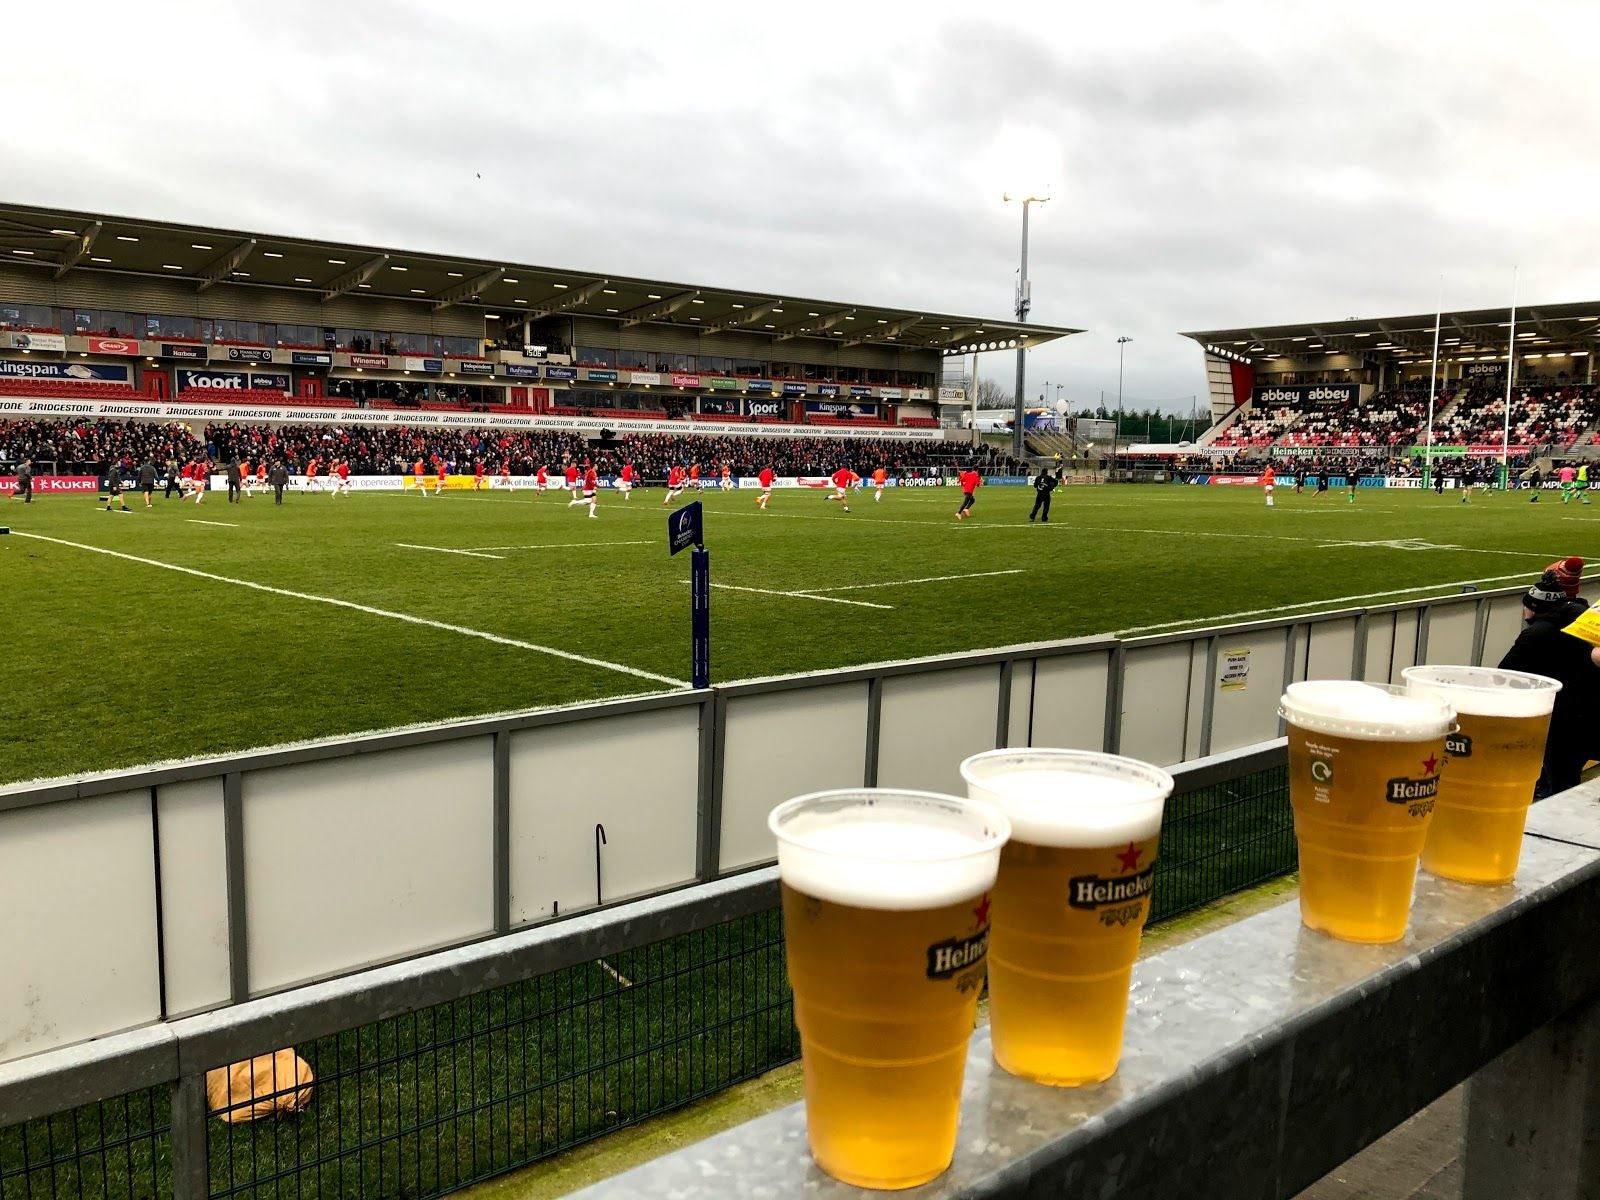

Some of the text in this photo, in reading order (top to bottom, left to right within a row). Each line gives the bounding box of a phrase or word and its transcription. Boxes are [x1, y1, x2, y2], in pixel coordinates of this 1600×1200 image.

[352, 357, 386, 366] Winemark
[1468, 363, 1502, 374] abbey
[253, 377, 273, 386] abbey
[674, 376, 699, 385] Tughans
[1261, 389, 1300, 403] abbey
[1308, 387, 1350, 401] abbey
[818, 403, 847, 413] Kingspan
[29, 402, 95, 413] BRIDGESTONE
[99, 404, 162, 415] BRIDGESTONE
[166, 407, 224, 417] BRIDGESTONE
[228, 409, 282, 418] BRIDGESTONE
[286, 410, 337, 420] BRIDGESTONE
[341, 412, 390, 421] BRIDGESTONE
[393, 414, 439, 423] BRIDGESTONE
[442, 415, 487, 424] BRIDGESTONE
[490, 417, 531, 425] BRIDGESTONE
[534, 418, 575, 426] BRIDGESTONE
[577, 420, 615, 428] BRIDGESTONE
[618, 421, 653, 430] BRIDGESTONE
[656, 422, 690, 430] BRIDGESTONE
[692, 424, 726, 432] BRIDGESTONE
[728, 425, 759, 433] BRIDGESTONE
[761, 426, 791, 434] BRIDGESTONE
[793, 427, 822, 436] BRIDGESTONE
[824, 428, 851, 436] BRIDGESTONE
[853, 429, 880, 437] BRIDGESTONE
[1272, 447, 1314, 456] Heineken
[51, 479, 96, 489] KUKRI
[360, 478, 403, 488] openreach
[905, 478, 914, 487] GO
[914, 478, 937, 487] POWER
[1359, 478, 1385, 487] 2020
[1076, 873, 1152, 902] Heineke
